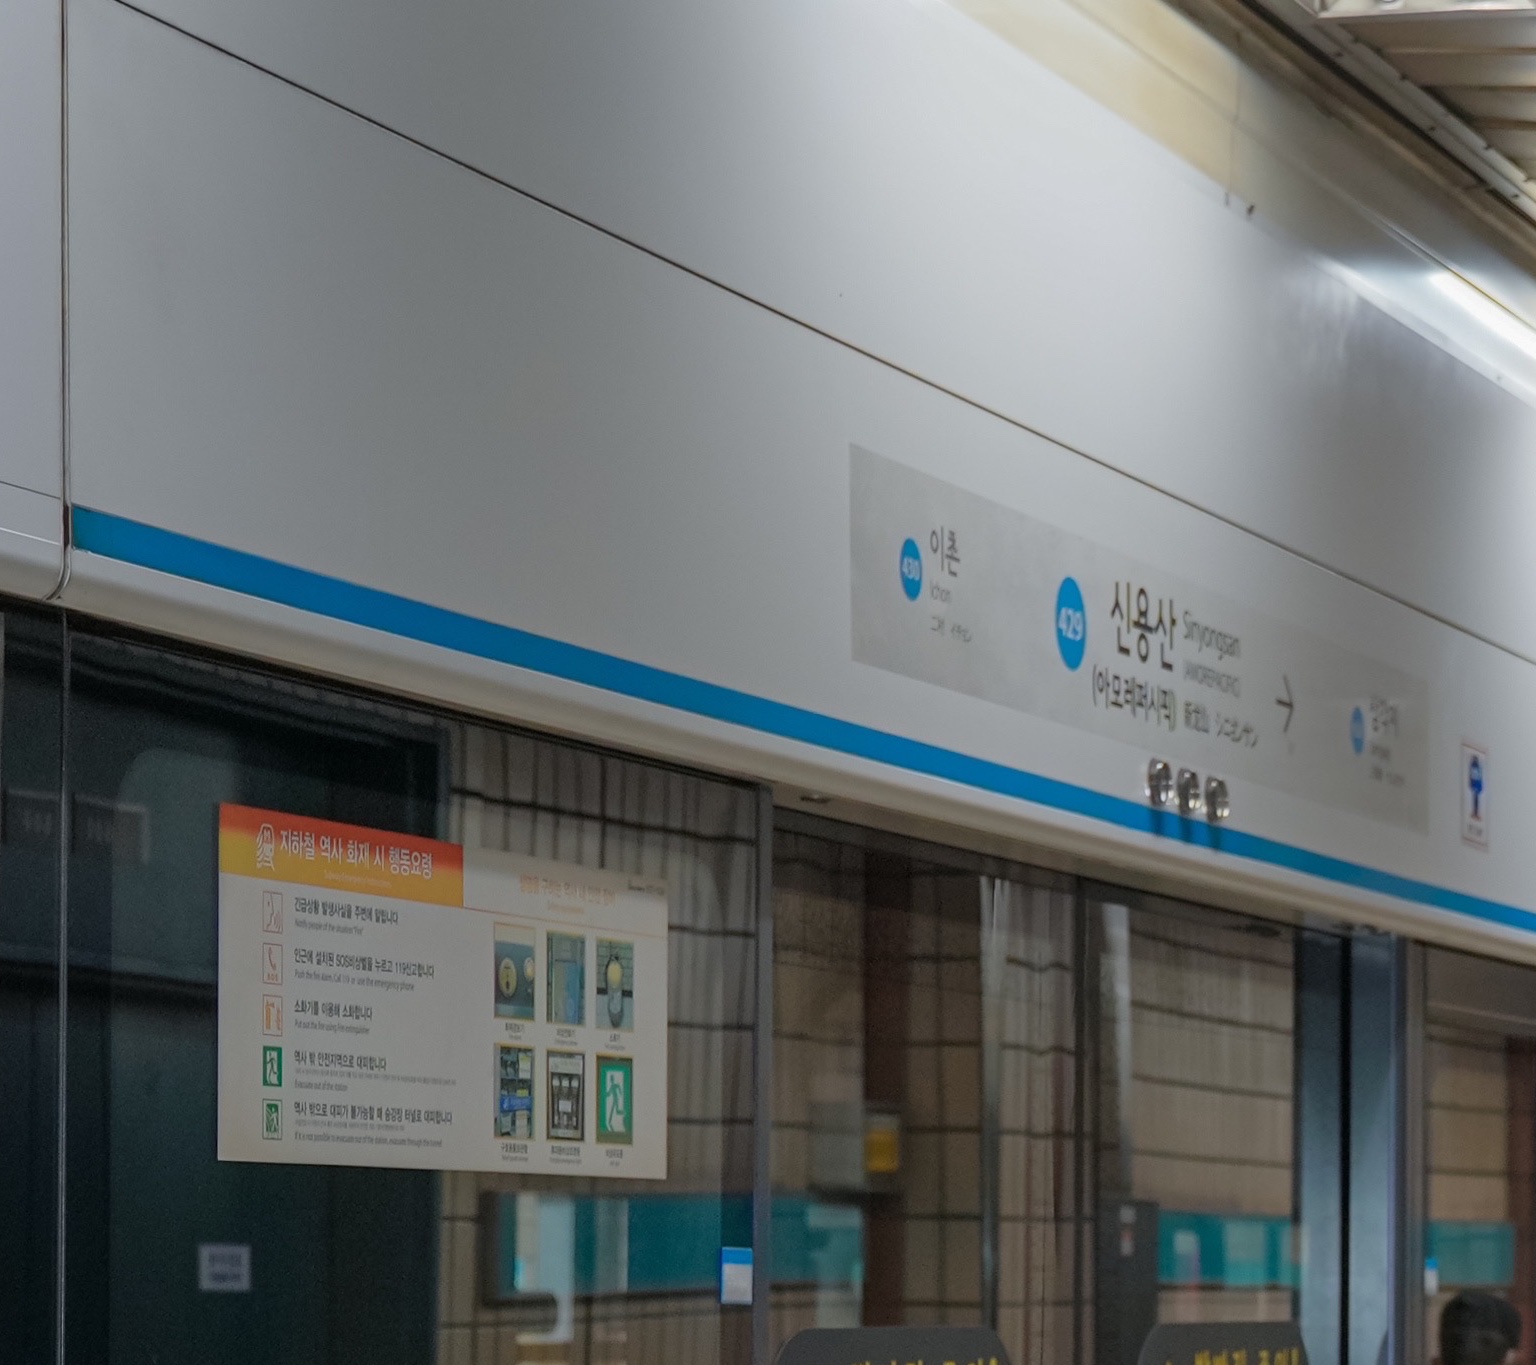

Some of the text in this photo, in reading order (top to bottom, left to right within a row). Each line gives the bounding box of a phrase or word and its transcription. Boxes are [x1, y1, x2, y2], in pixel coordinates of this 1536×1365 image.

[929, 524, 961, 578] 이촌
[901, 556, 921, 582] 430
[1057, 604, 1084, 642] 429
[1110, 580, 1178, 673] 신용산
[1092, 663, 1177, 733] (아모레퍼시픽)
[279, 829, 315, 862] 지하철
[319, 834, 343, 865] 역사
[346, 839, 370, 870] 화재
[373, 845, 385, 872] 시
[388, 847, 433, 880] 행동요령
[294, 896, 320, 915] 긴급상황
[354, 904, 373, 923] 주변에
[293, 947, 435, 980] 인근에 설치된 SOS비상벨을 누르고 119신고합니다
[294, 999, 373, 1021] 소화기를 이용해 소화합니다
[293, 1049, 307, 1066] 역사
[317, 1052, 355, 1069] 안전지역으로
[356, 1055, 387, 1072] 대피합니다
[293, 1101, 307, 1116] 역사
[308, 1102, 328, 1118] 밖으로
[330, 1105, 349, 1119] 대피가
[350, 1105, 375, 1121] 불가능할
[384, 1107, 403, 1124] 승강장
[404, 1108, 423, 1123] 터널로
[423, 1110, 453, 1126] 대피합니다
